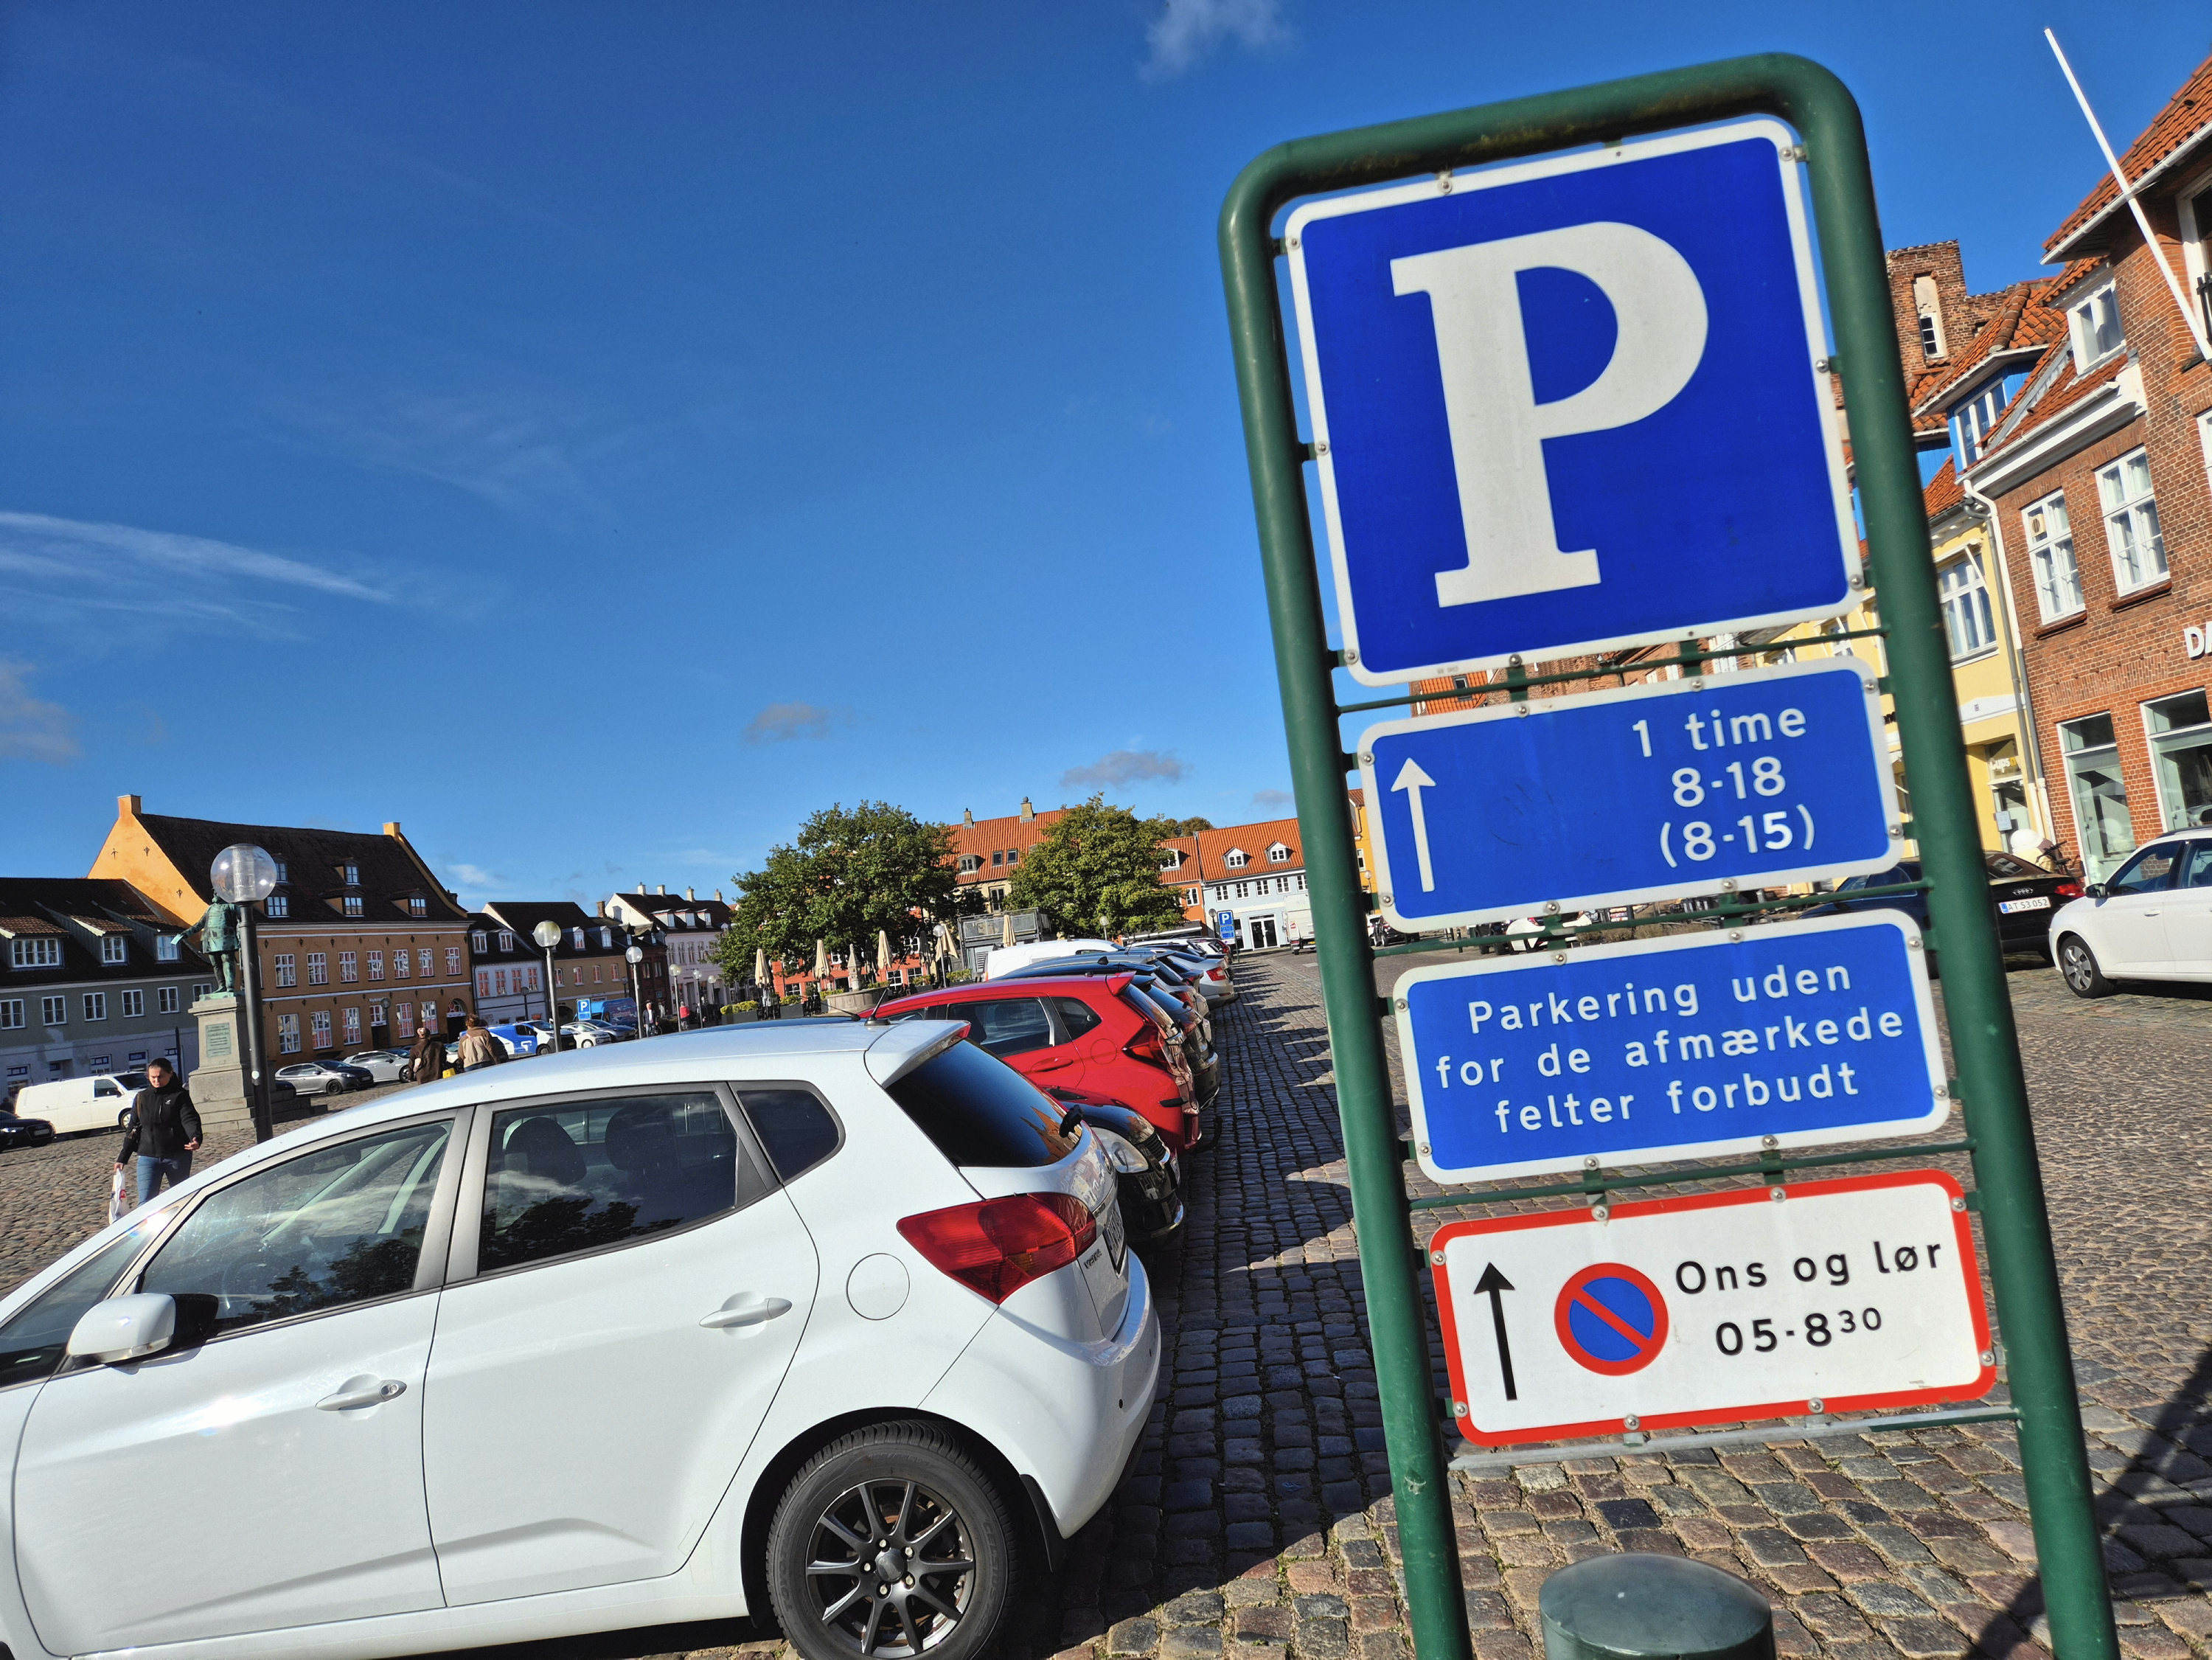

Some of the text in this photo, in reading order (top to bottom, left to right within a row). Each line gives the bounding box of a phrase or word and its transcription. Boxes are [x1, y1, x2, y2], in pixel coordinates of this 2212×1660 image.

[1390, 221, 1709, 608] P
[1632, 707, 1806, 758] 1 time
[1671, 756, 1786, 808] 8-18
[1660, 803, 1815, 869] (8-15)
[1221, 913, 1230, 924] P
[2008, 898, 2048, 911] AT 53 052
[580, 1001, 588, 1011] P
[1468, 964, 1851, 1035] Parkering uden
[1435, 1006, 1903, 1089] for de afmærkede
[1494, 1061, 1859, 1133] felter forbudt
[1674, 1240, 1941, 1295] Ons og lør
